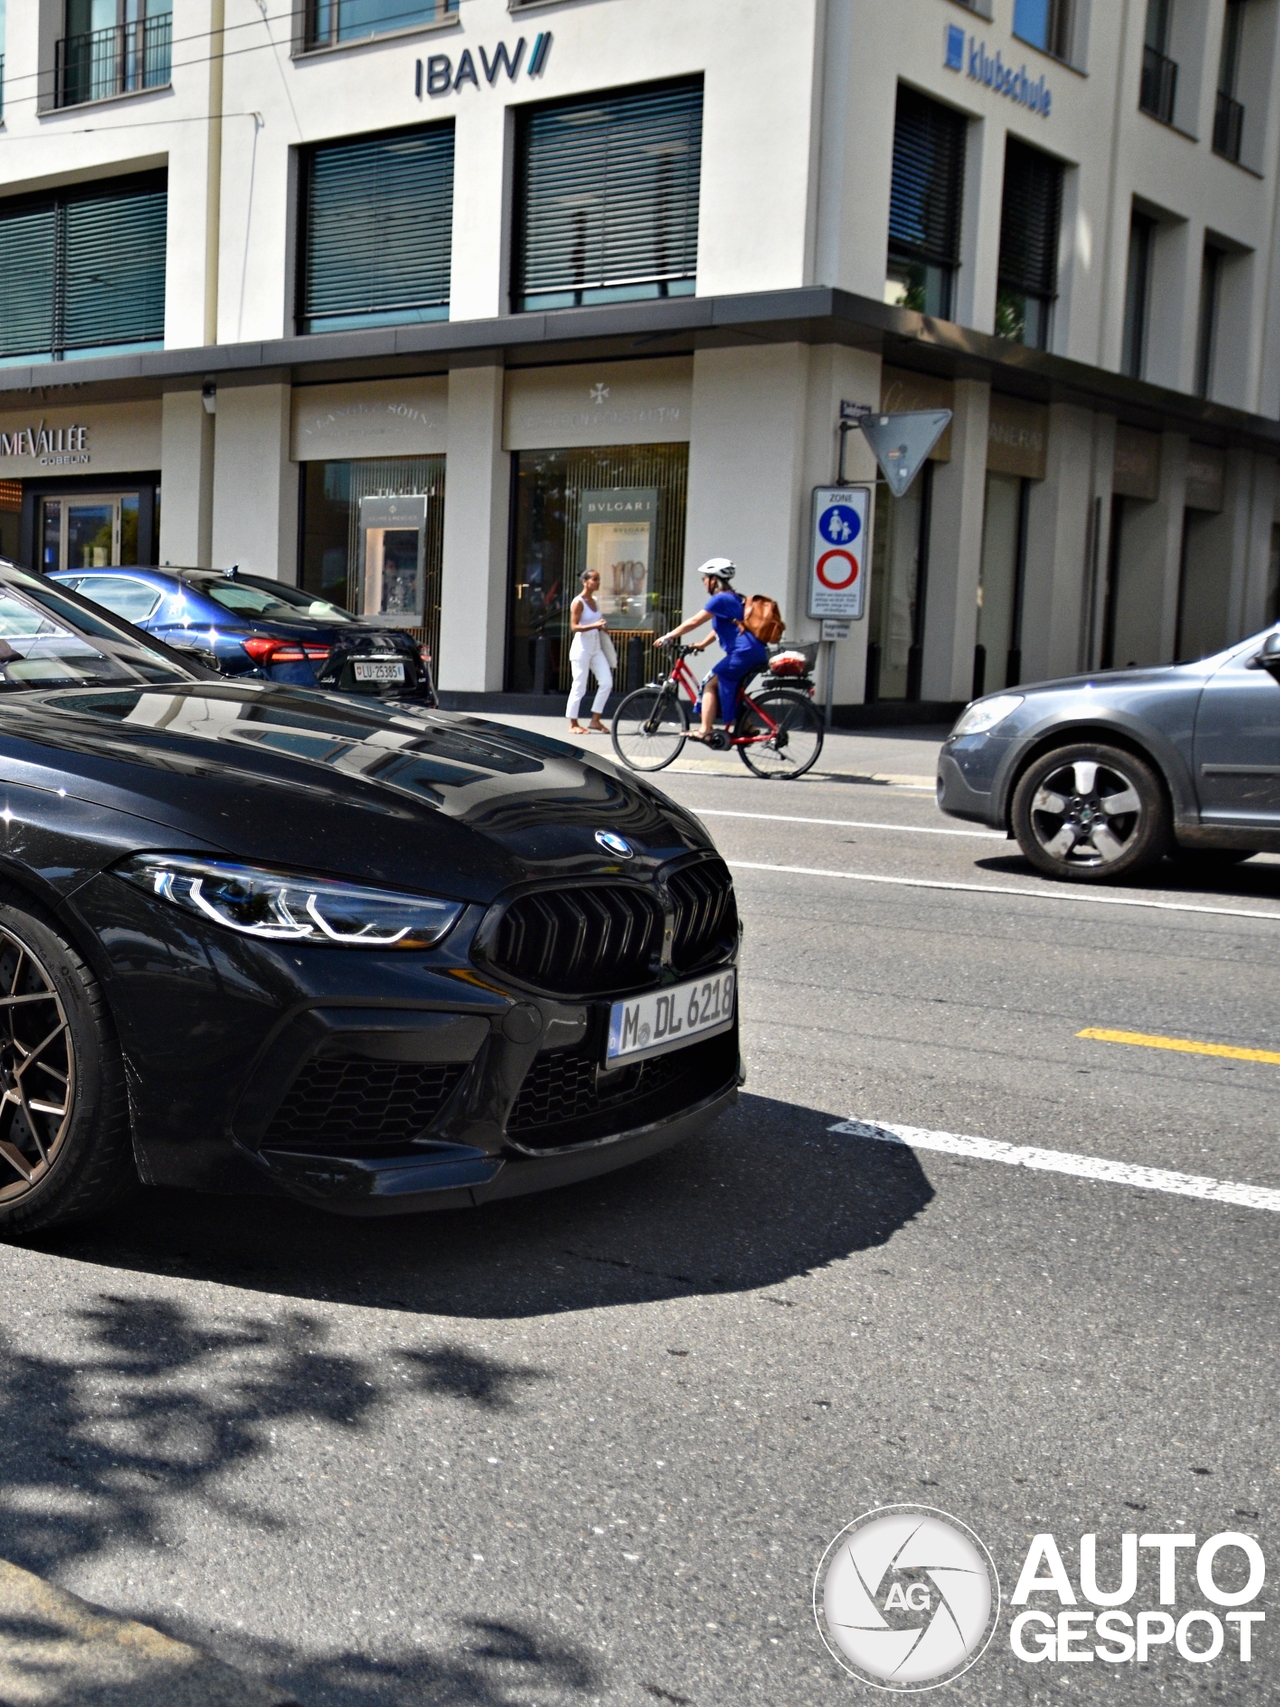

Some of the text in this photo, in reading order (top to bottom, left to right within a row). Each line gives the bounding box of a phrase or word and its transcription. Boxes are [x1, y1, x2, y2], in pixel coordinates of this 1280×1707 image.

[969, 36, 1052, 117] klubschule
[988, 422, 1043, 451] ANERAI
[588, 502, 650, 512] BVLGARI
[829, 493, 853, 503] ZONE
[622, 1004, 640, 1049] M
[653, 993, 682, 1039] DL
[687, 975, 734, 1028] 6218
